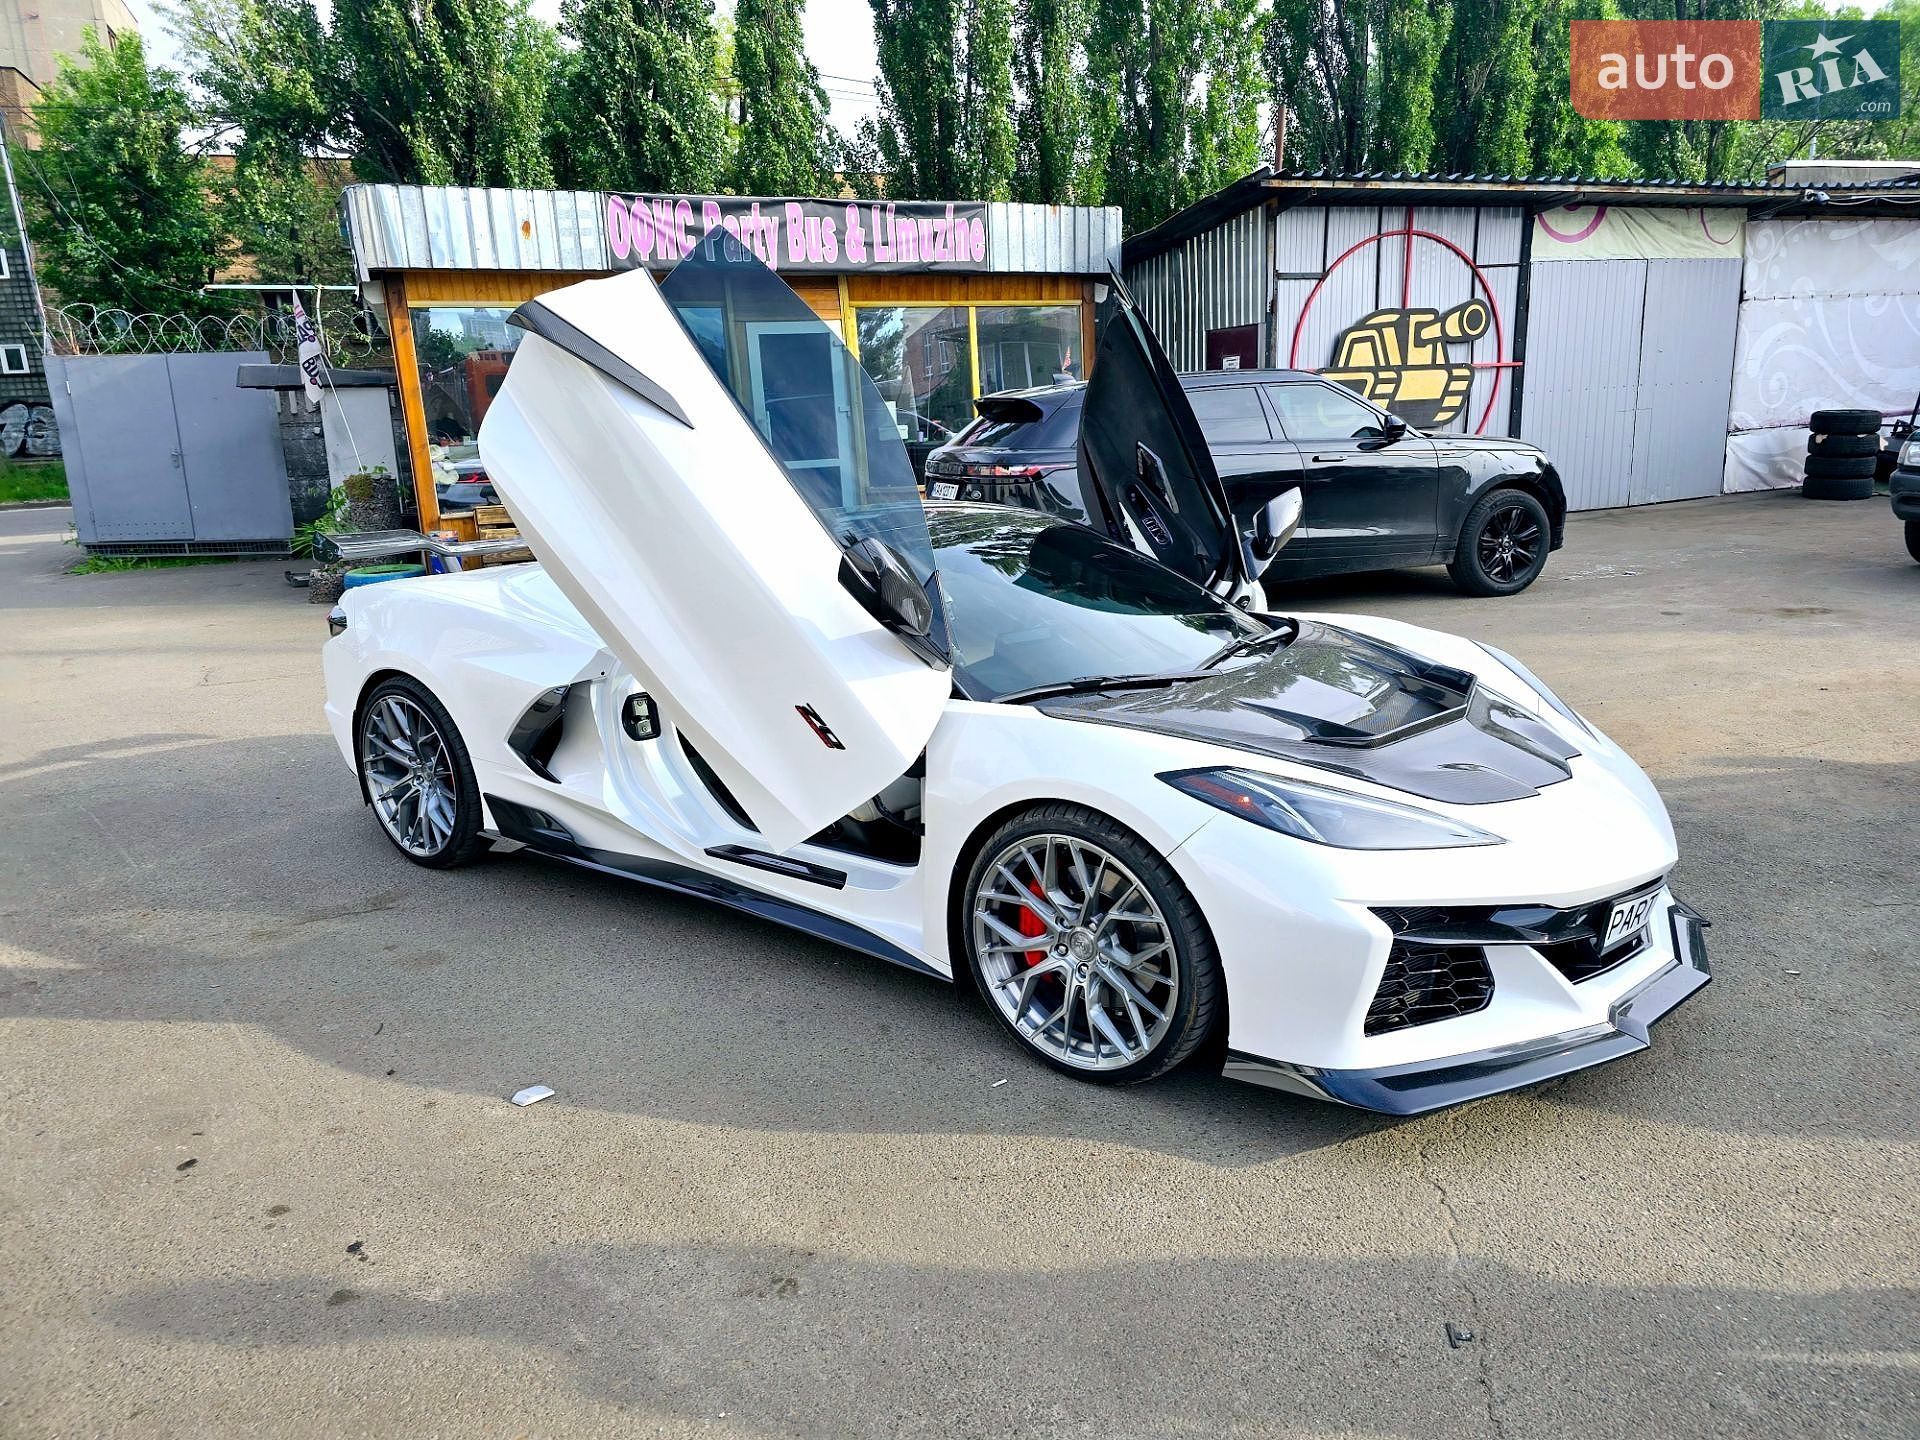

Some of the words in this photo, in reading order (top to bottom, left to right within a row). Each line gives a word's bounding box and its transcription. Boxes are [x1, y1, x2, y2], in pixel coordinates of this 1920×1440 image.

[608, 195, 696, 262] ОФИС
[703, 200, 779, 271] Party
[785, 202, 838, 263] Bus
[845, 203, 867, 263] &
[871, 203, 985, 262] Limuzine
